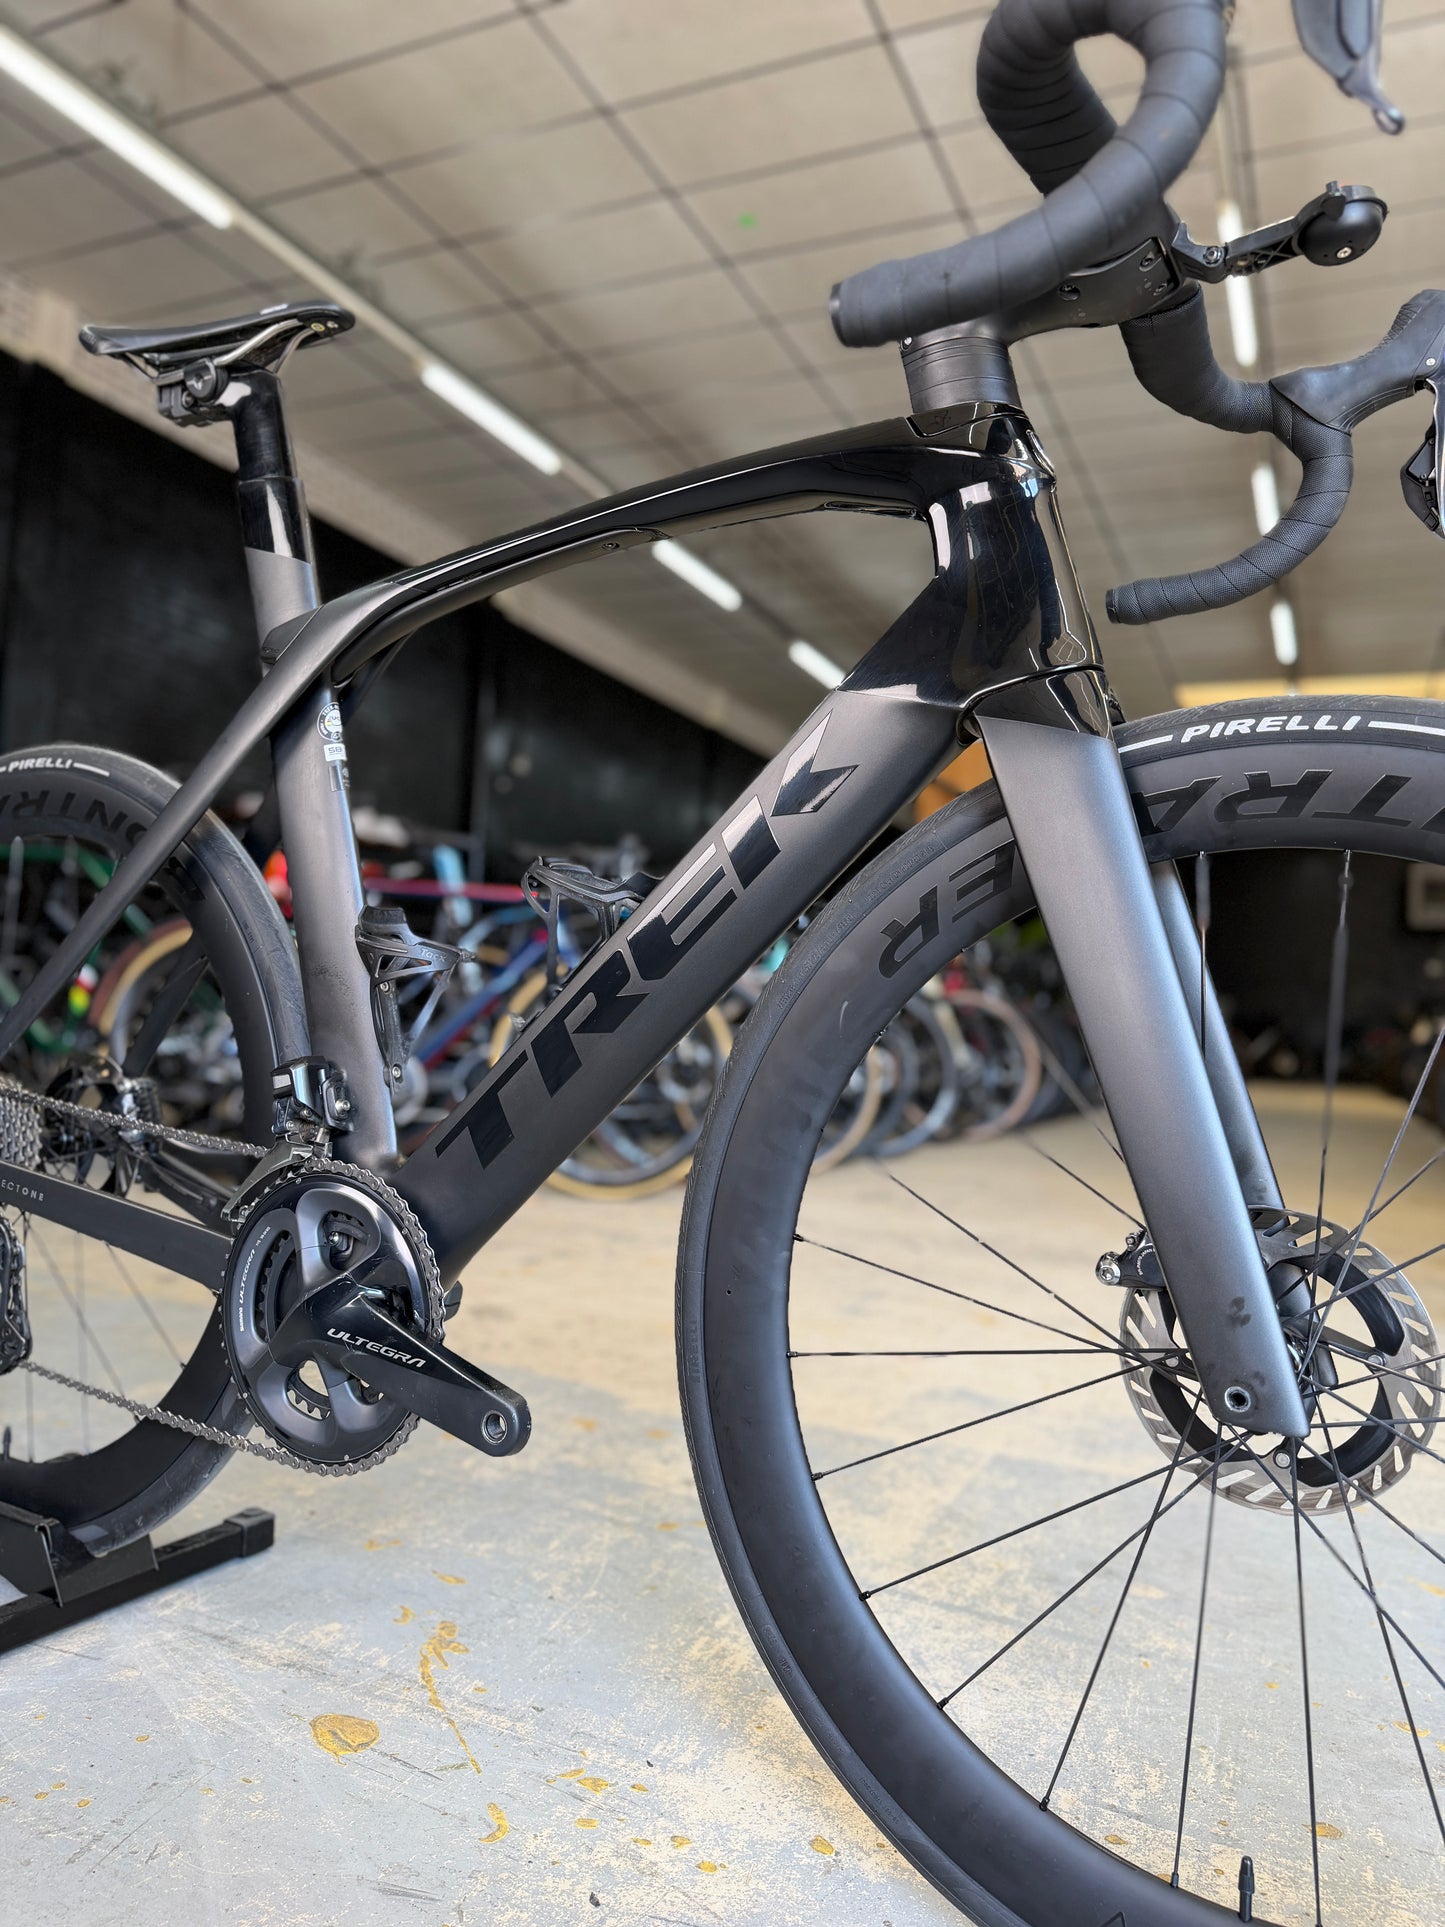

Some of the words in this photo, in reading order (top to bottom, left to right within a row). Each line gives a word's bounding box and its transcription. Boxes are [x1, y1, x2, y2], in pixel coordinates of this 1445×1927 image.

[1180, 714, 1362, 743] PIRELLI
[8, 757, 73, 773] PIRELLI
[435, 709, 859, 1170] TREK
[420, 947, 447, 963] Tacx
[1, 1179, 44, 1202] ECTONE
[239, 1248, 256, 1305] ULTEGRA
[326, 1327, 427, 1368] ULTEGRA
